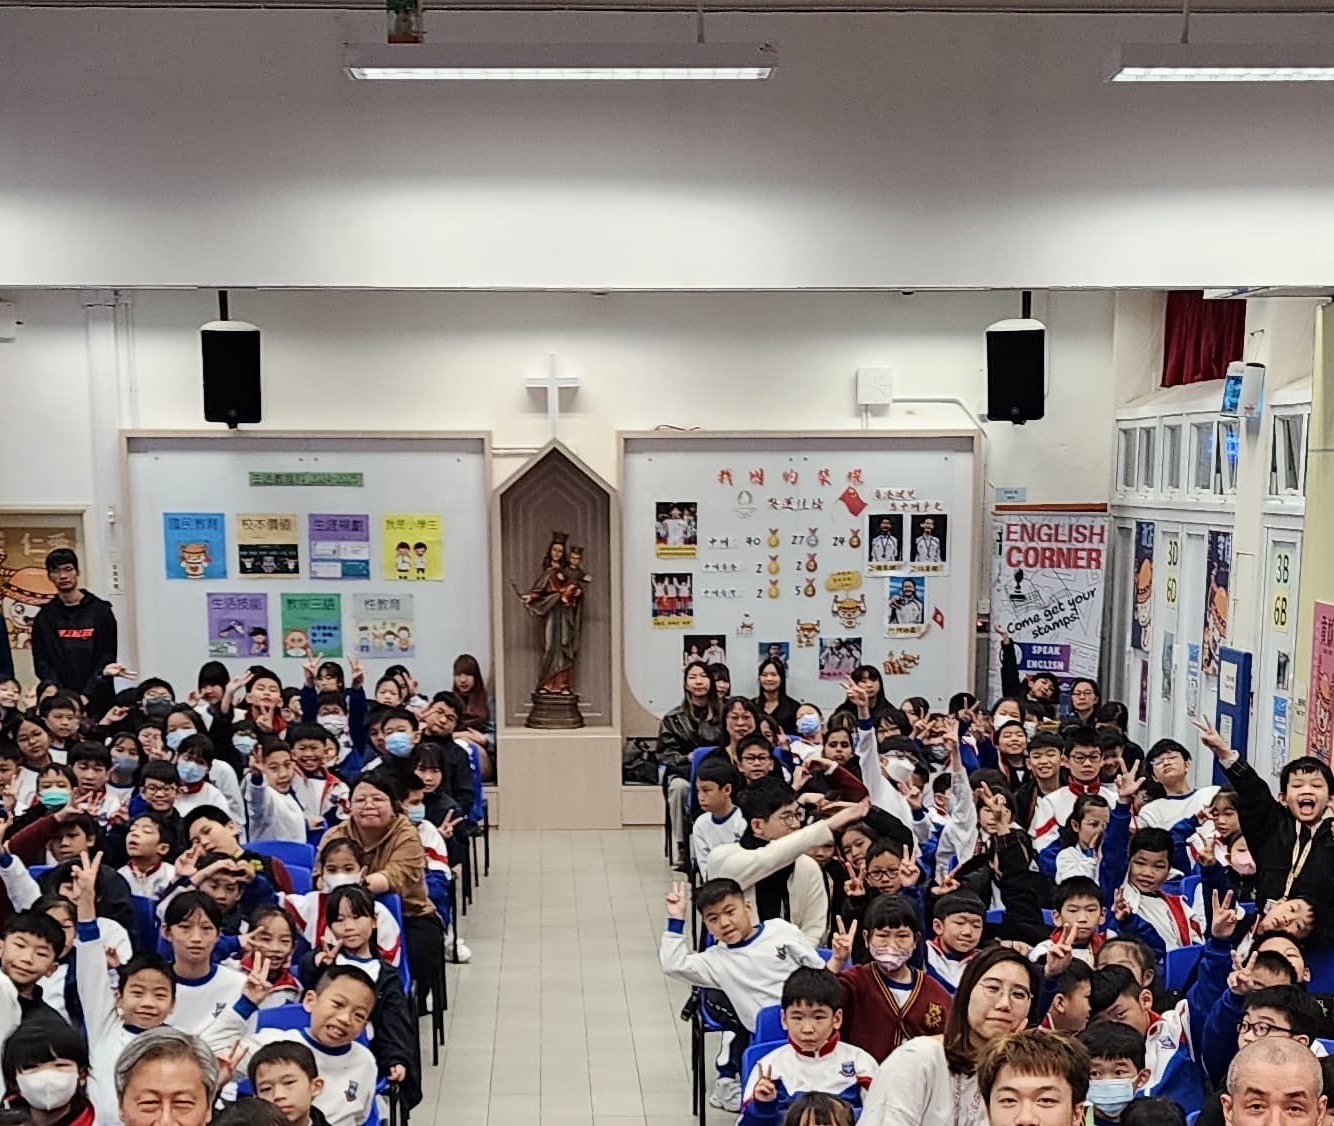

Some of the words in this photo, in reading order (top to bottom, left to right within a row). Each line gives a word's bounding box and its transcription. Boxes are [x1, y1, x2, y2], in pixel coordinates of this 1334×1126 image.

[791, 535, 804, 545] 27
[1005, 523, 1105, 544] ENGLISH
[1006, 546, 1102, 570] CORNER
[1276, 554, 1289, 584] 3B
[1007, 614, 1042, 635] Come
[1043, 601, 1066, 622] get
[1067, 587, 1097, 612] your
[1031, 607, 1080, 639] stamps!
[1274, 596, 1288, 626] 6B
[1031, 645, 1061, 656] SPEAK
[1026, 659, 1064, 671] ENGLISH
